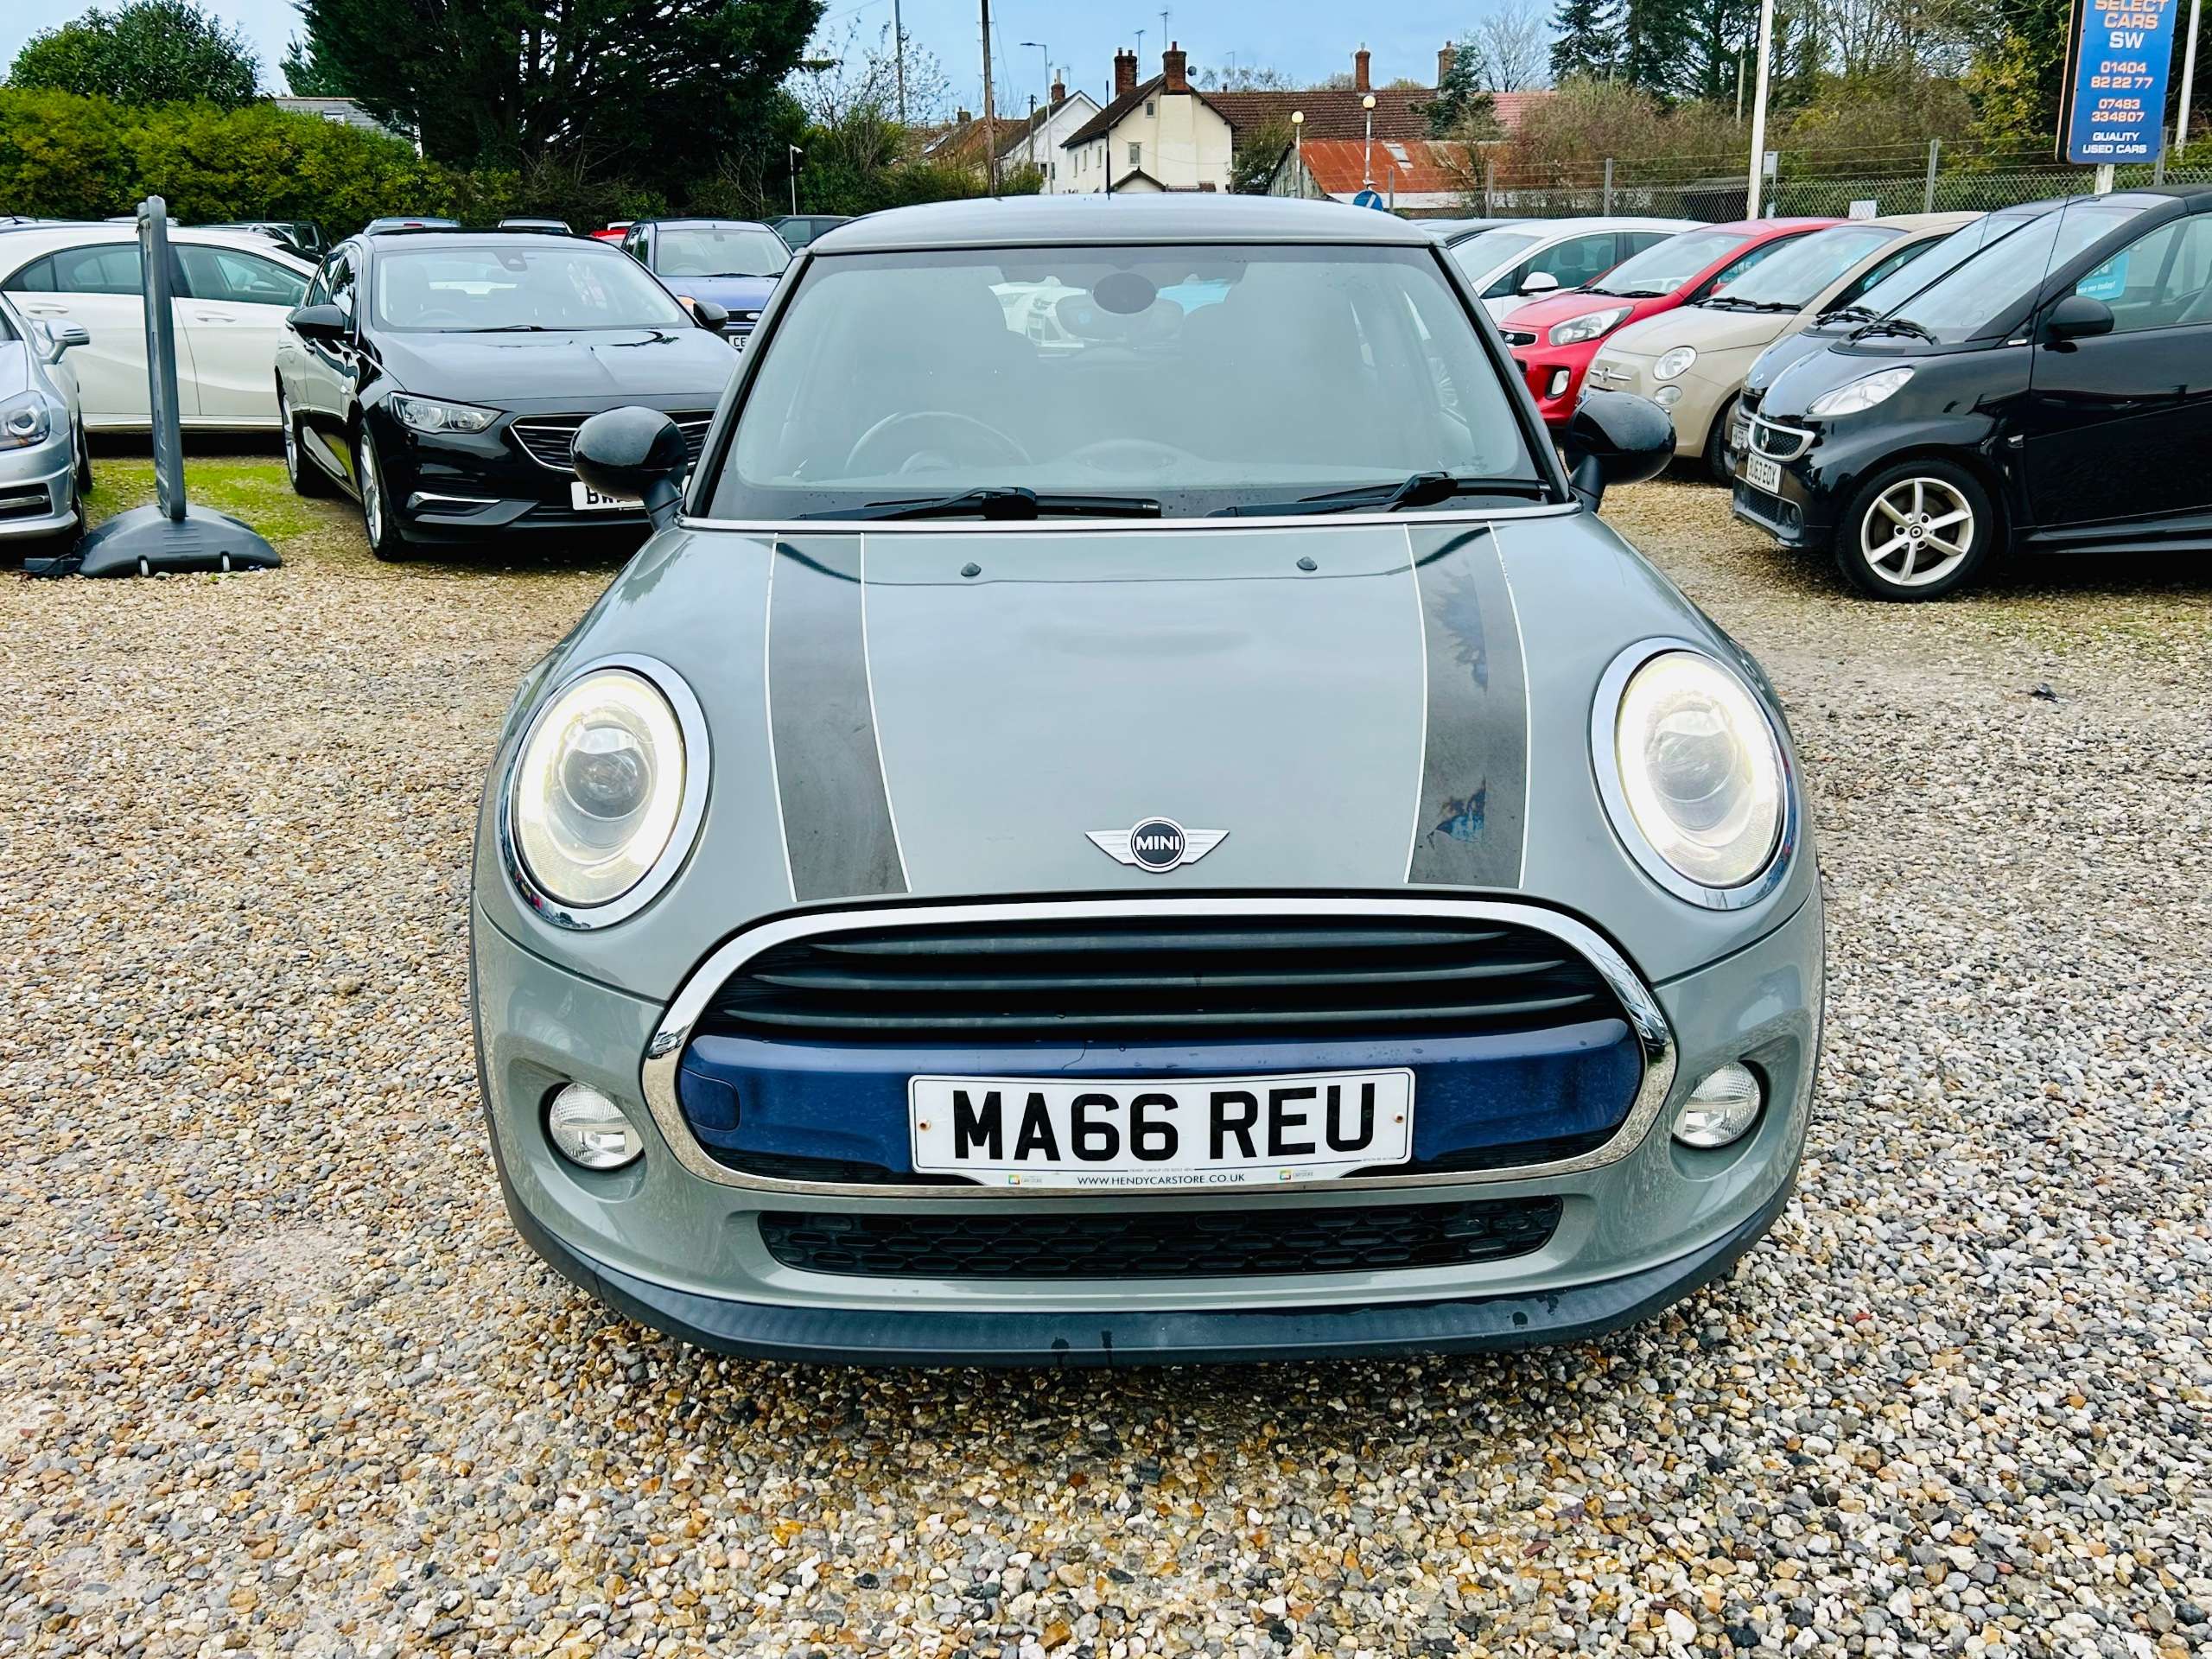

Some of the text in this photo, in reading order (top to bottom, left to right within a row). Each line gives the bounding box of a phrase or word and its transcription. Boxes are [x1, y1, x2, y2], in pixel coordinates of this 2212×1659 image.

[2094, 0, 2169, 13] SELECT
[2104, 12, 2158, 29] CARS
[2109, 31, 2145, 48] SW
[2100, 60, 2147, 73] 01404
[2099, 99, 2140, 110] 07483
[2092, 111, 2145, 122] 334807
[2092, 131, 2140, 142] QUALITY
[2082, 144, 2147, 154] USED CARS
[1135, 836, 1181, 851] MINI
[953, 1083, 1376, 1162] MA66 REU
